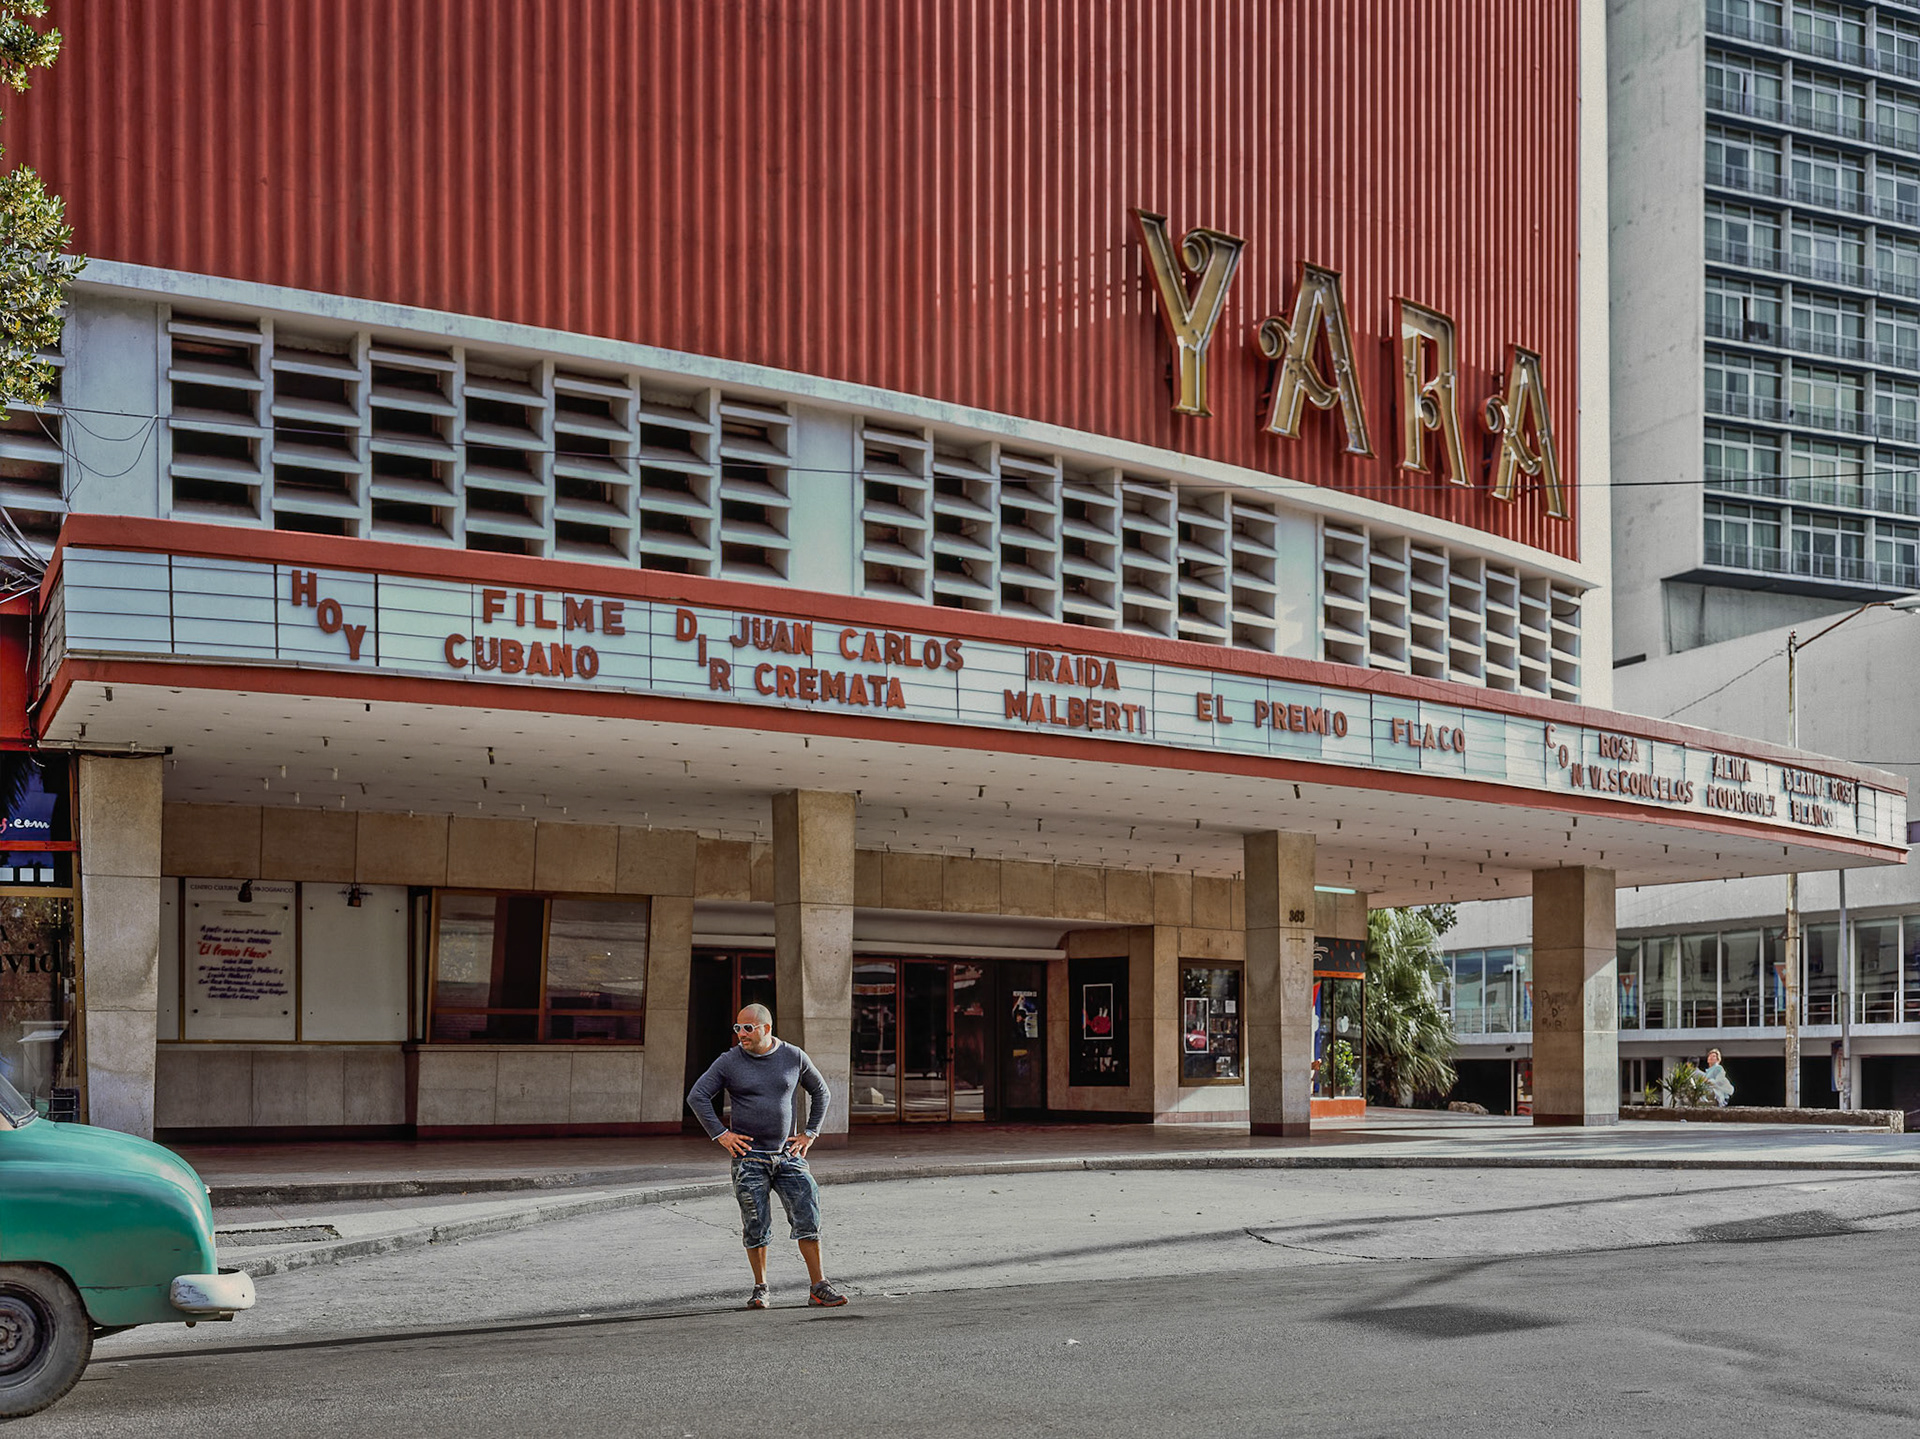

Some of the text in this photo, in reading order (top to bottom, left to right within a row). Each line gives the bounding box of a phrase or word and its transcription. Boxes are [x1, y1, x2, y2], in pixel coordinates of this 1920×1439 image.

[1129, 207, 1572, 521] YARA
[291, 569, 367, 661] HOY
[482, 588, 626, 636] FILME
[444, 634, 600, 680] CUBANO
[675, 607, 732, 692] DIR
[729, 615, 964, 672] JUAN CARLOS
[754, 662, 906, 709] CREMATA
[1028, 650, 1121, 691] IRAIDA
[1003, 688, 1147, 735] MALBERTI
[1196, 691, 1467, 754] EL PREMIO FLACO
[1545, 722, 1583, 788] CON
[1598, 731, 1641, 764] ROSA
[1712, 752, 1752, 783] ALINA
[1588, 764, 1694, 804] VASCONCELOS
[1706, 783, 1777, 818] RODRIGUEZ
[1783, 767, 1857, 805] BLANCA ROSA
[1791, 799, 1835, 828] BLANCO
[0, 942, 61, 974] vid
